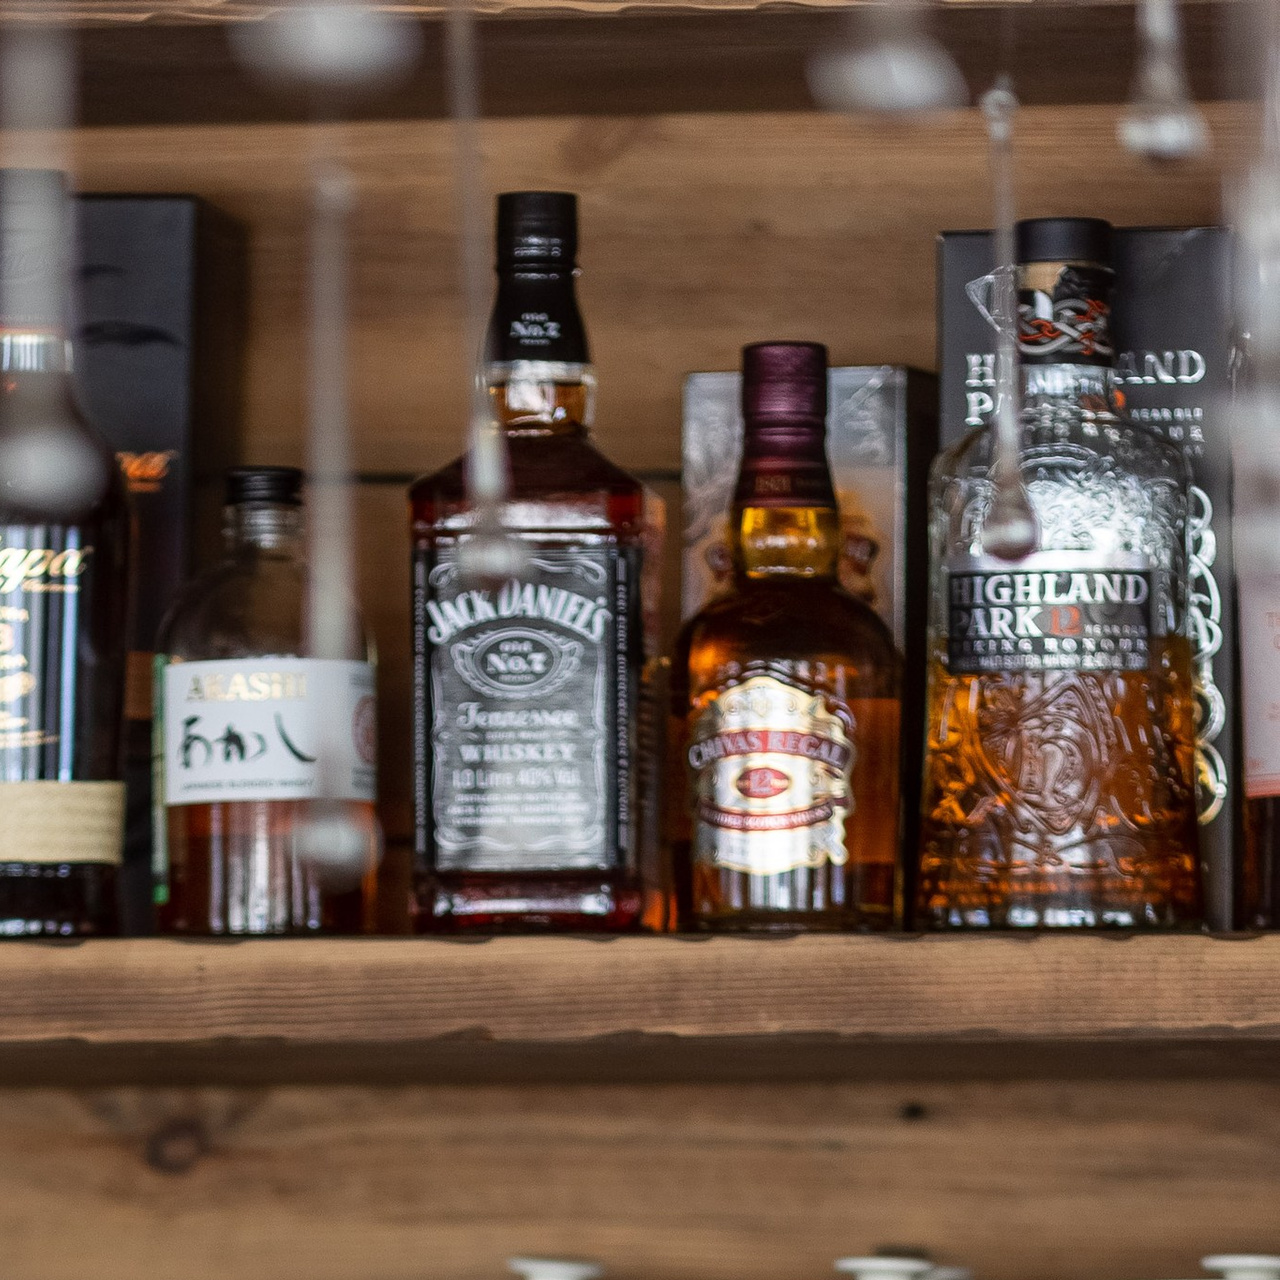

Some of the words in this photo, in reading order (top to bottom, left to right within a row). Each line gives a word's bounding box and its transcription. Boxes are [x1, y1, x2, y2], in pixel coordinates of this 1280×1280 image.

[951, 572, 1150, 605] HIGHLAND
[425, 589, 497, 645] JACK
[497, 578, 614, 644] DANIEL'S
[951, 605, 1044, 640] PARK
[1049, 606, 1083, 637] 12
[485, 652, 548, 675] No.7
[187, 672, 307, 700] AKASHI
[459, 743, 577, 763] WHISKEY
[688, 730, 762, 770] CHIVAS
[767, 730, 848, 770] REGAL
